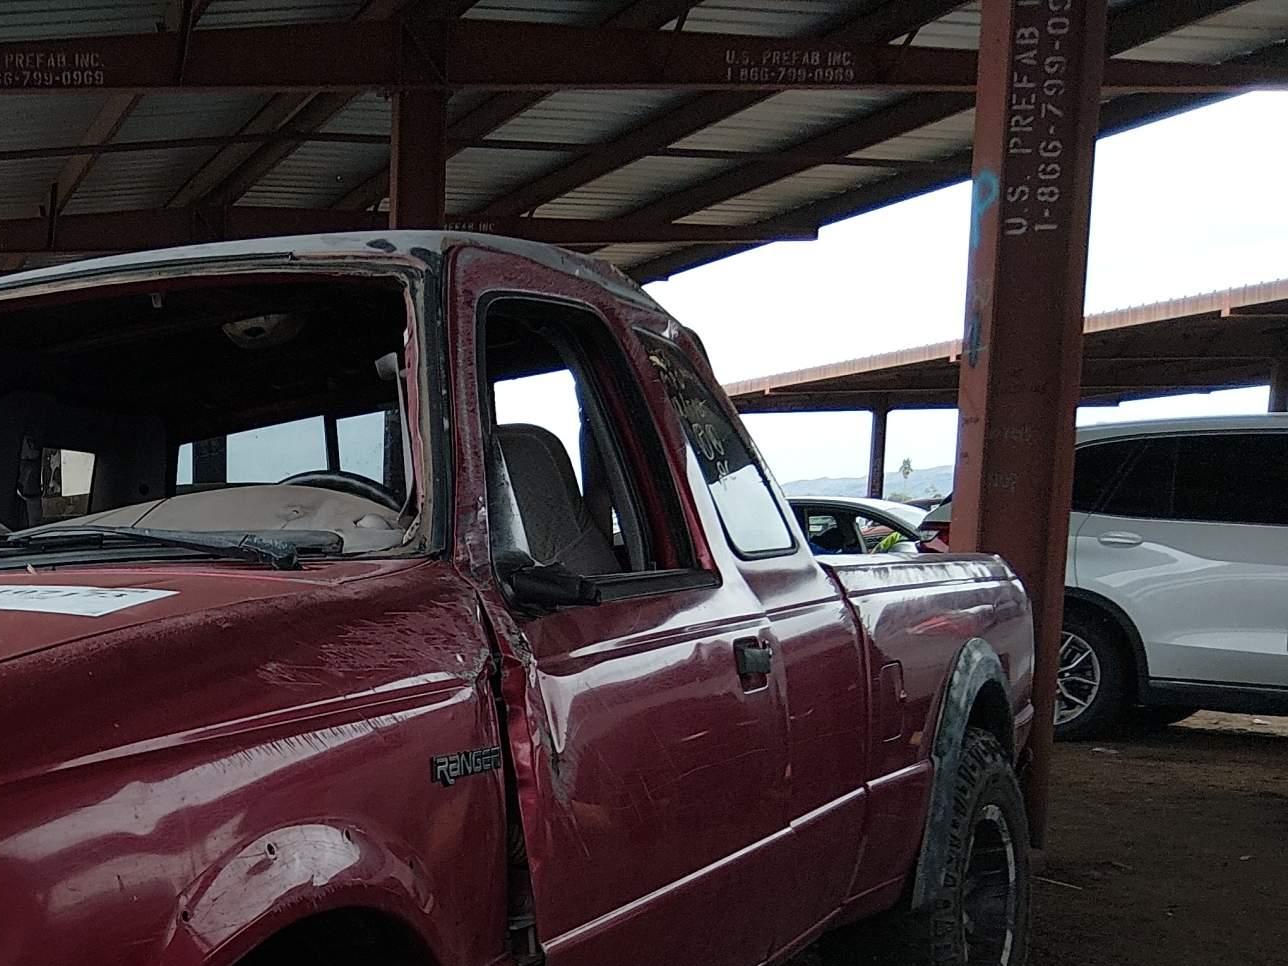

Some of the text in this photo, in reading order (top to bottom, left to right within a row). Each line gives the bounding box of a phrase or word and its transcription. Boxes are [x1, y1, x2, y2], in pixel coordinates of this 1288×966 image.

[4, 53, 67, 68] PREFAB
[762, 50, 820, 65] PREFAB
[1009, 26, 1040, 154] PREFAB
[1004, 175, 1031, 236] U.S.
